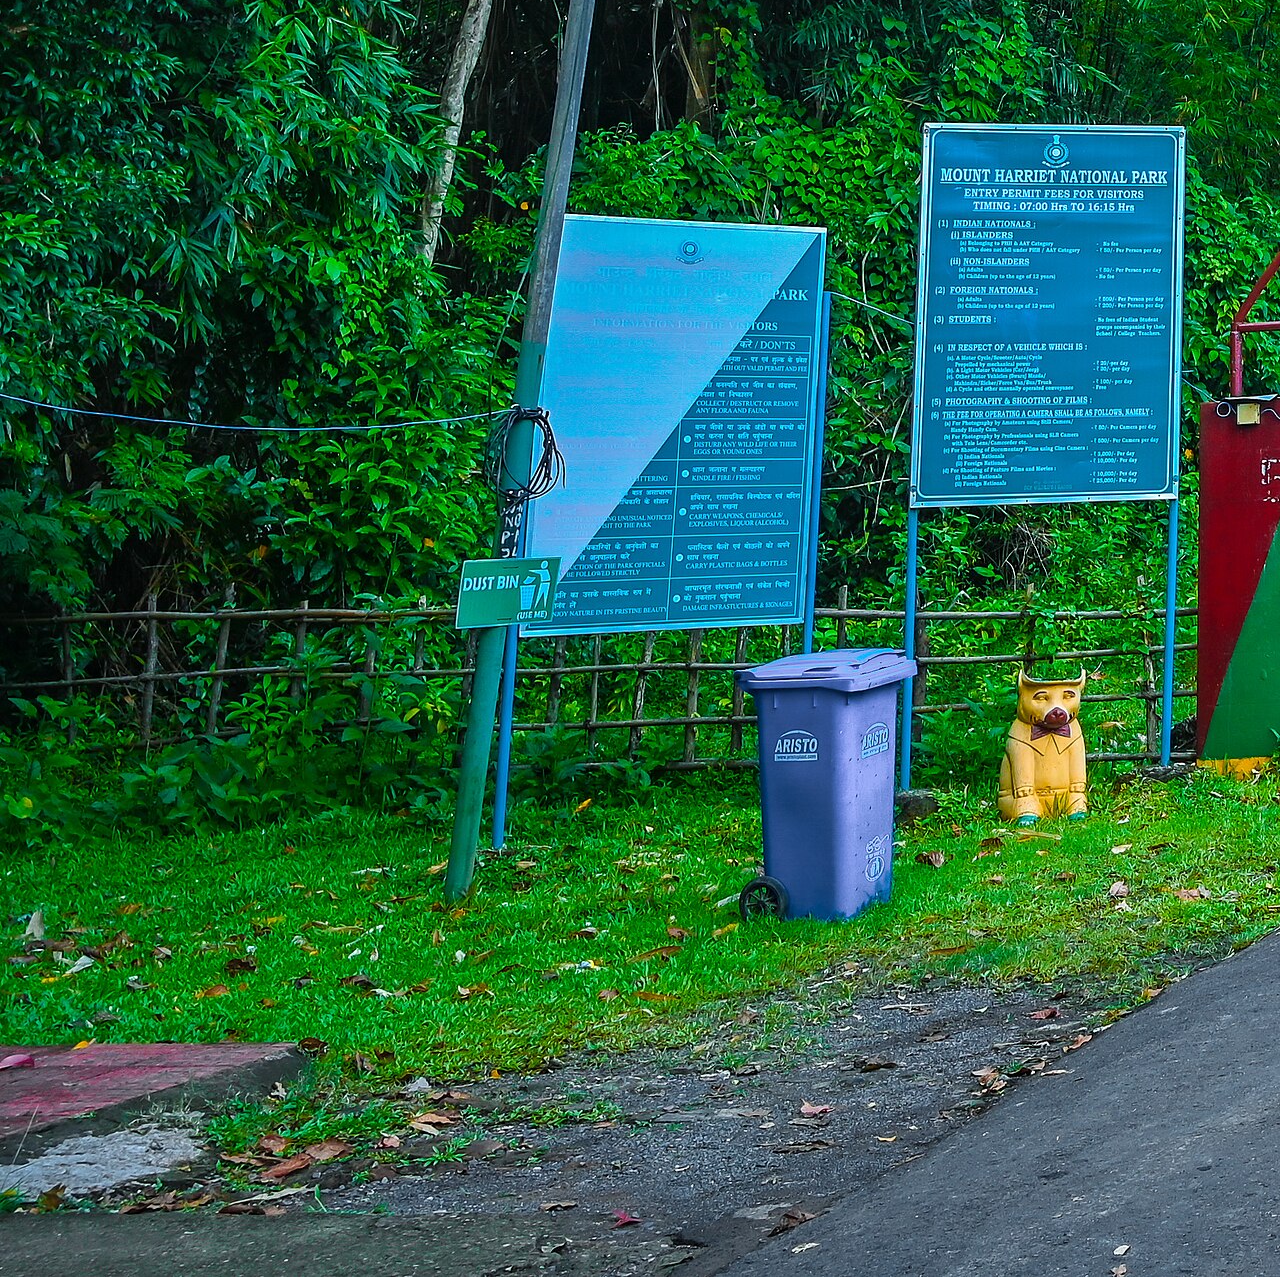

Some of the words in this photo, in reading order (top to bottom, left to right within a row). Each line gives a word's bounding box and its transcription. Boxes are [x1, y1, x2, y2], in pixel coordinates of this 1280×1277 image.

[941, 168, 990, 182] MOUNT
[995, 170, 1056, 182] HARRIET
[1061, 170, 1127, 183] NATIONAL
[1132, 171, 1167, 184] PARK
[965, 189, 998, 197] ENTRY
[1045, 189, 1070, 198] FEES
[1074, 190, 1093, 198] FOR
[1097, 190, 1144, 198] VISITORS
[973, 202, 1010, 210] TIMING
[1020, 202, 1047, 210] 07:00
[1089, 203, 1114, 211] 16:15
[1118, 203, 1135, 211] Hrs
[938, 220, 948, 228] (1)
[951, 231, 960, 240] (i)
[950, 258, 960, 266] (ii)
[773, 290, 808, 301] PARK
[935, 287, 945, 295] (2)
[934, 316, 944, 324] (3)
[934, 344, 943, 353] (4)
[931, 412, 939, 420] (6)
[1126, 408, 1149, 416] NAMELY
[463, 577, 494, 591] DUST
[497, 575, 519, 589] BIN
[517, 611, 532, 620] (USE
[535, 611, 548, 619] ME)
[862, 728, 889, 750] ARISTO
[775, 739, 818, 752] ARISTO
